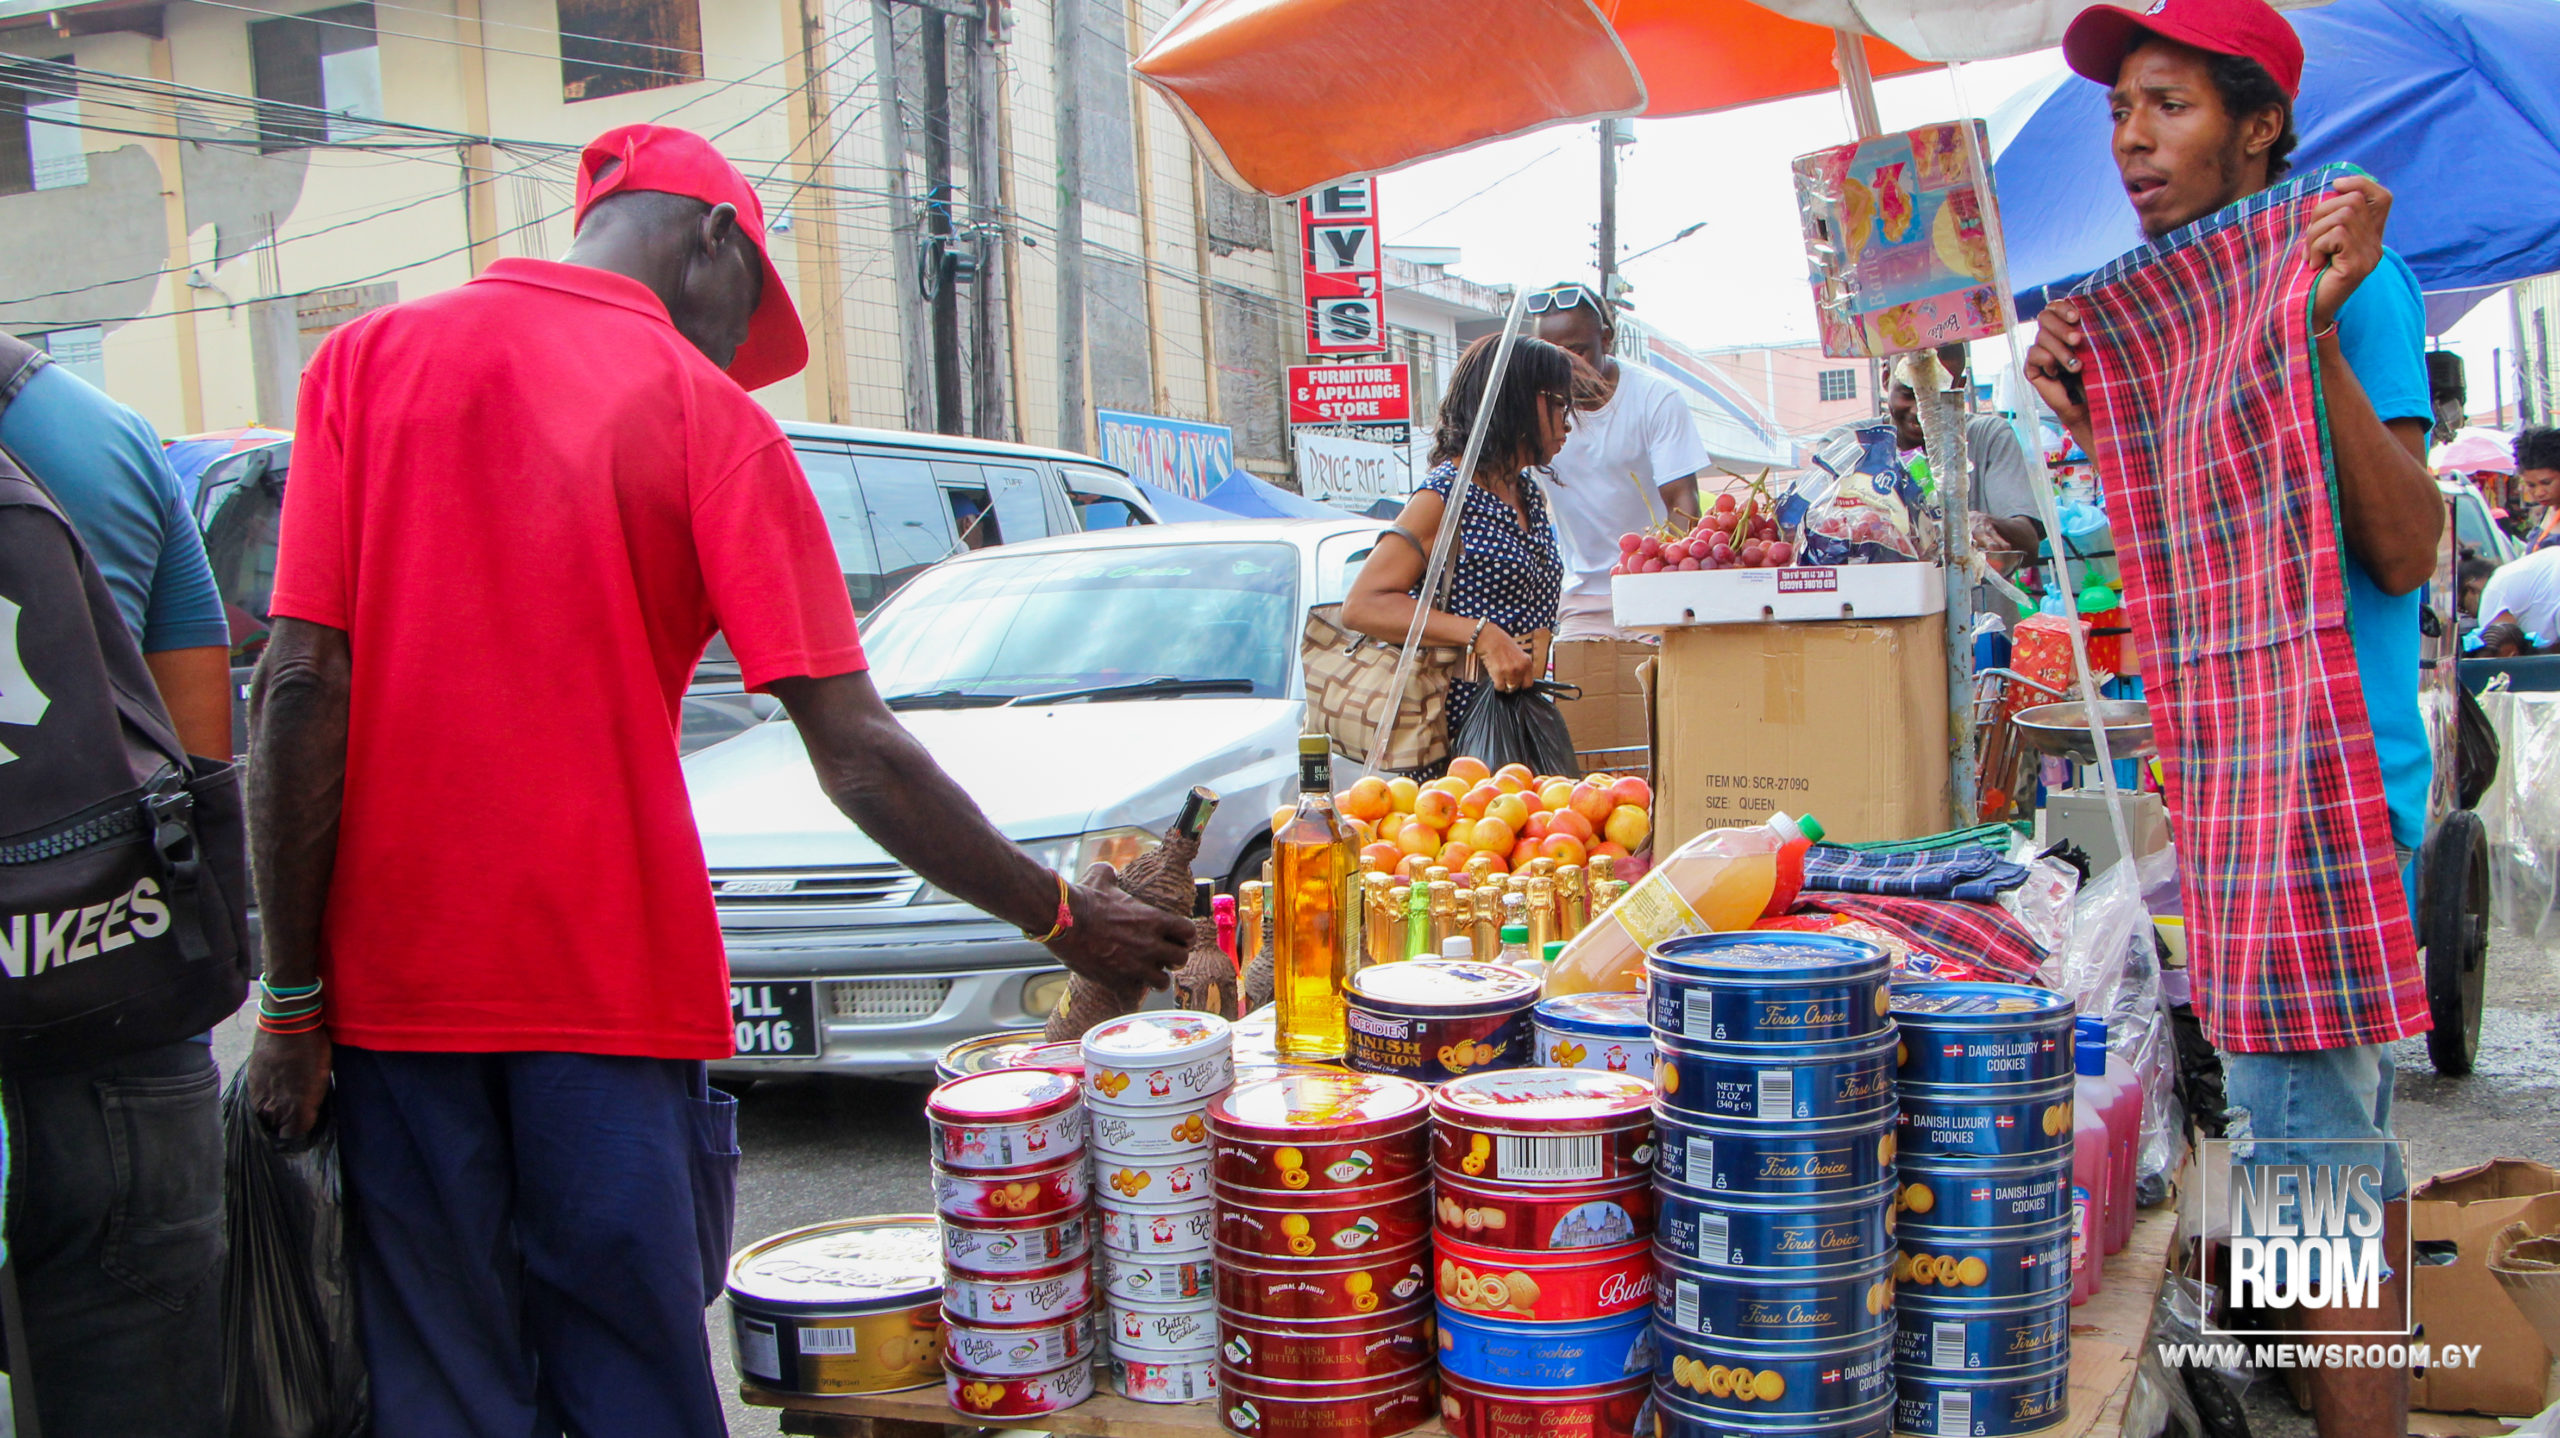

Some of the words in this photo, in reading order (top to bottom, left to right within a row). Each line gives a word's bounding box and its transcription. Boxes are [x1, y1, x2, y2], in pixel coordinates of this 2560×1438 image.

[1308, 368, 1392, 385] FURNITURE
[1297, 387, 1310, 401] &
[1315, 384, 1401, 401] APPLIANCE
[1319, 401, 1380, 417] STORE
[1309, 447, 1353, 492] PRICE
[1355, 458, 1388, 494] RITE
[1779, 580, 1803, 590] BAGGED
[1803, 579, 1823, 589] GLOBE
[1823, 579, 1836, 589] RED
[1705, 775, 1730, 788] ITEM
[1732, 776, 1751, 788] NO:
[1752, 776, 1810, 791] SCR-2709Q
[1705, 796, 1731, 809] SIZE:
[1739, 797, 1775, 811] QUEEN
[729, 986, 783, 1017] PLL
[1759, 1006, 1800, 1026] First
[1804, 1004, 1847, 1023] Choice
[1349, 1015, 1408, 1039] MERIDIEN
[734, 1020, 795, 1052] 016
[1351, 1046, 1422, 1068] LECTION
[1968, 1043, 2004, 1057] DANISH
[2006, 1041, 2039, 1056] LUXURY
[1986, 1058, 2026, 1072] COOKIES
[1178, 1060, 1213, 1088] Butter
[1716, 1082, 1735, 1091] NET
[1736, 1084, 1752, 1092] WT
[1840, 1077, 1870, 1098] First
[1727, 1092, 1741, 1100] OZ
[1098, 1118, 1127, 1137] Butter
[1913, 1115, 1950, 1128] DANISH
[1952, 1116, 1990, 1128] LUXURY
[1108, 1130, 1135, 1146] Cookies
[1931, 1130, 1974, 1143] COOKIES
[1333, 1164, 1354, 1177] VIP
[1510, 1167, 1551, 1176] 906064
[1555, 1167, 1596, 1176] 281015
[1759, 1157, 1799, 1177] First
[1804, 1156, 1847, 1176] Choice
[1995, 1185, 2028, 1201] DANISH
[2029, 1181, 2056, 1197] LUXURY
[2012, 1198, 2046, 1214] COOKIES
[1340, 1231, 1360, 1244] VIP
[1777, 1231, 1816, 1250] First
[1820, 1229, 1860, 1248] Choice
[1025, 1280, 1063, 1306] Butter
[1298, 1282, 1326, 1296] DANISH
[1398, 1280, 1413, 1293] VIP
[1041, 1286, 1070, 1311] Cookies
[1742, 1304, 1783, 1324] First
[1786, 1304, 1832, 1324] Choice
[1153, 1315, 1192, 1336] Butter
[1168, 1323, 1200, 1344] Cookies
[961, 1337, 994, 1356] Butter
[2010, 1331, 2040, 1350] First
[973, 1350, 1002, 1365] Cookies
[1226, 1346, 1239, 1357] VIP
[1306, 1353, 1352, 1365] COOKIES
[1527, 1342, 1583, 1360] Cookies
[1052, 1365, 1082, 1394] Butter
[1535, 1364, 1576, 1379] Pride
[1844, 1361, 1872, 1382] DANISH
[1859, 1371, 1885, 1392] COOKIES
[1899, 1400, 1918, 1409] NET
[1919, 1402, 1933, 1410] WT
[2014, 1398, 2043, 1418] First
[1232, 1411, 1246, 1423] VIP
[1316, 1416, 1362, 1428] COOKIES
[1488, 1406, 1533, 1425] Butter
[1539, 1407, 1595, 1426] Cookies
